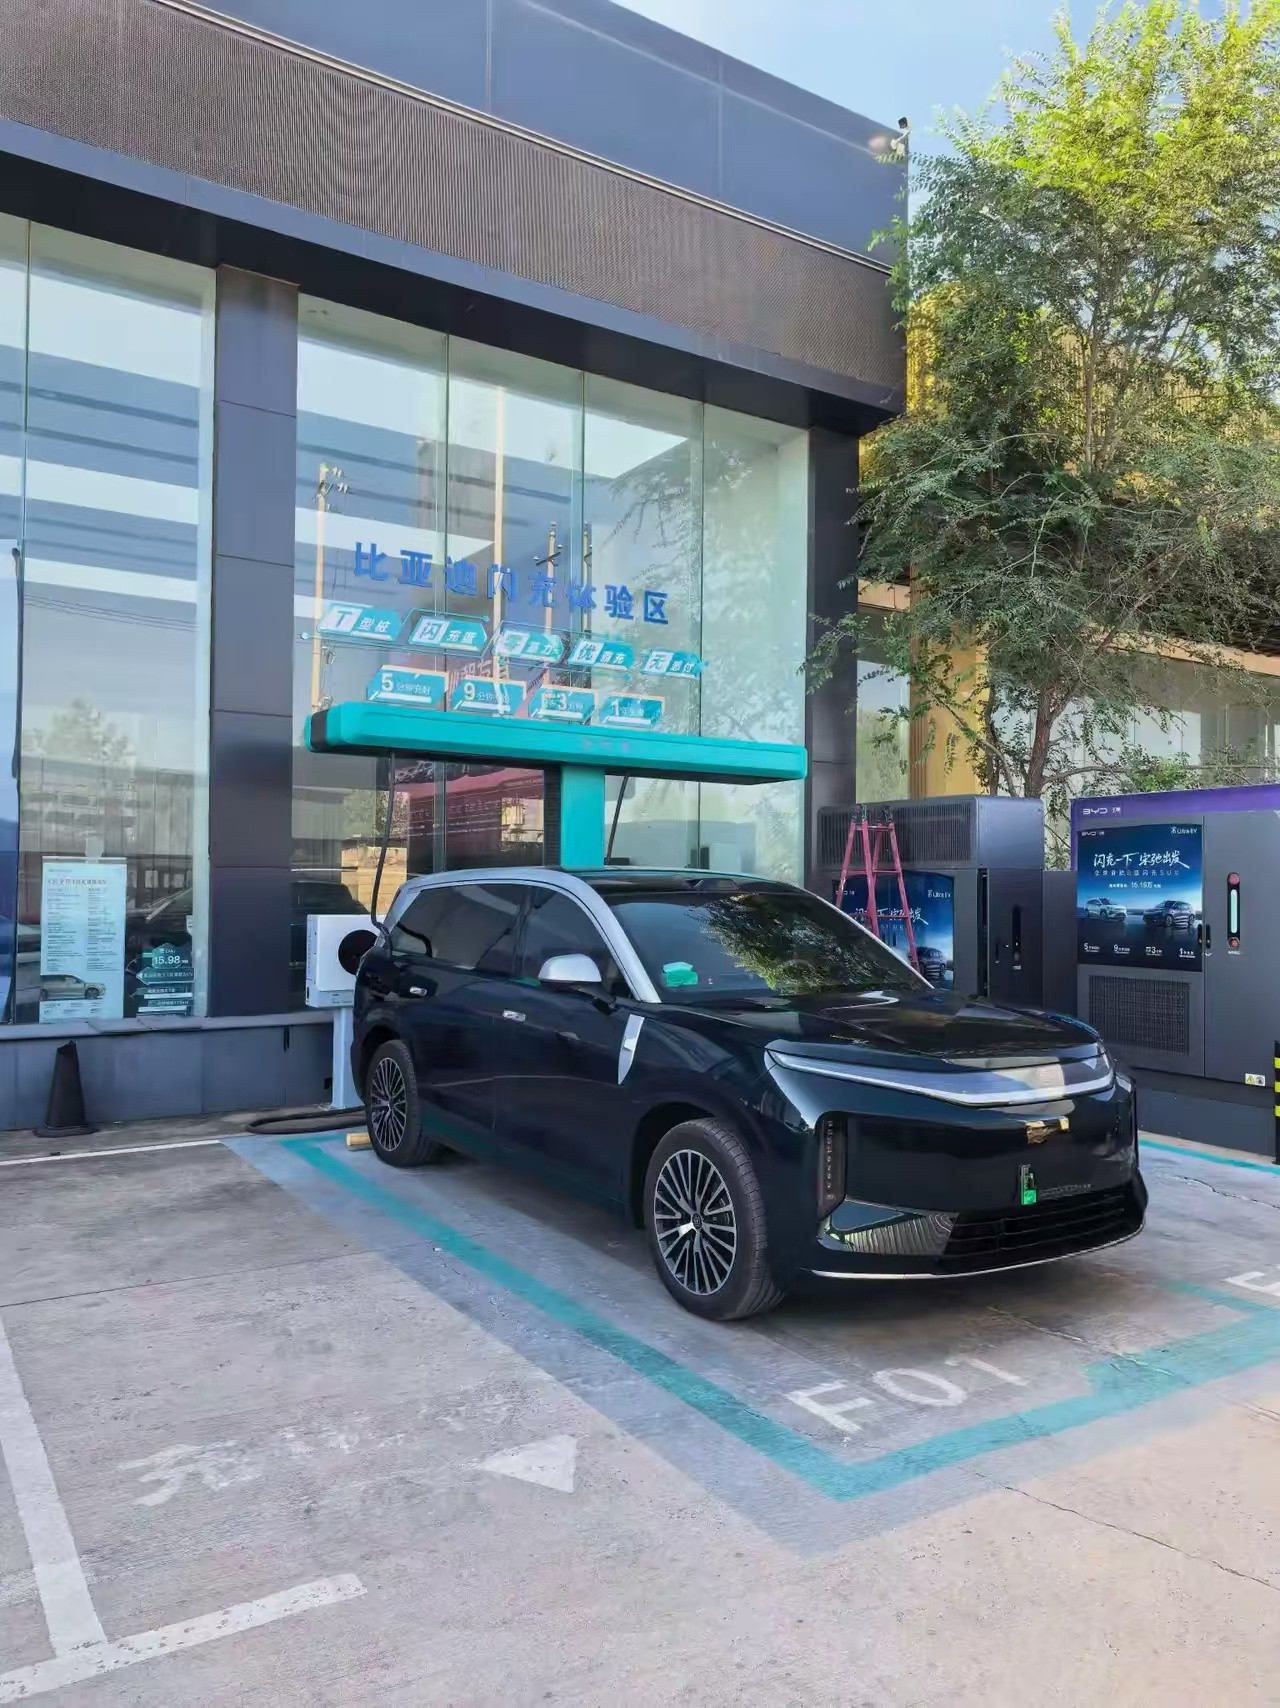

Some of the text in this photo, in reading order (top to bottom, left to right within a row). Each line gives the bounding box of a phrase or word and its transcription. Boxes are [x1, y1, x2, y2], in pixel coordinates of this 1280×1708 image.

[352, 541, 670, 625] 比亚迪闪充体验区
[1082, 807, 1108, 815] BYD
[1093, 849, 1191, 870] 闪充一下 宋驰出发
[154, 955, 181, 965] 15.98
